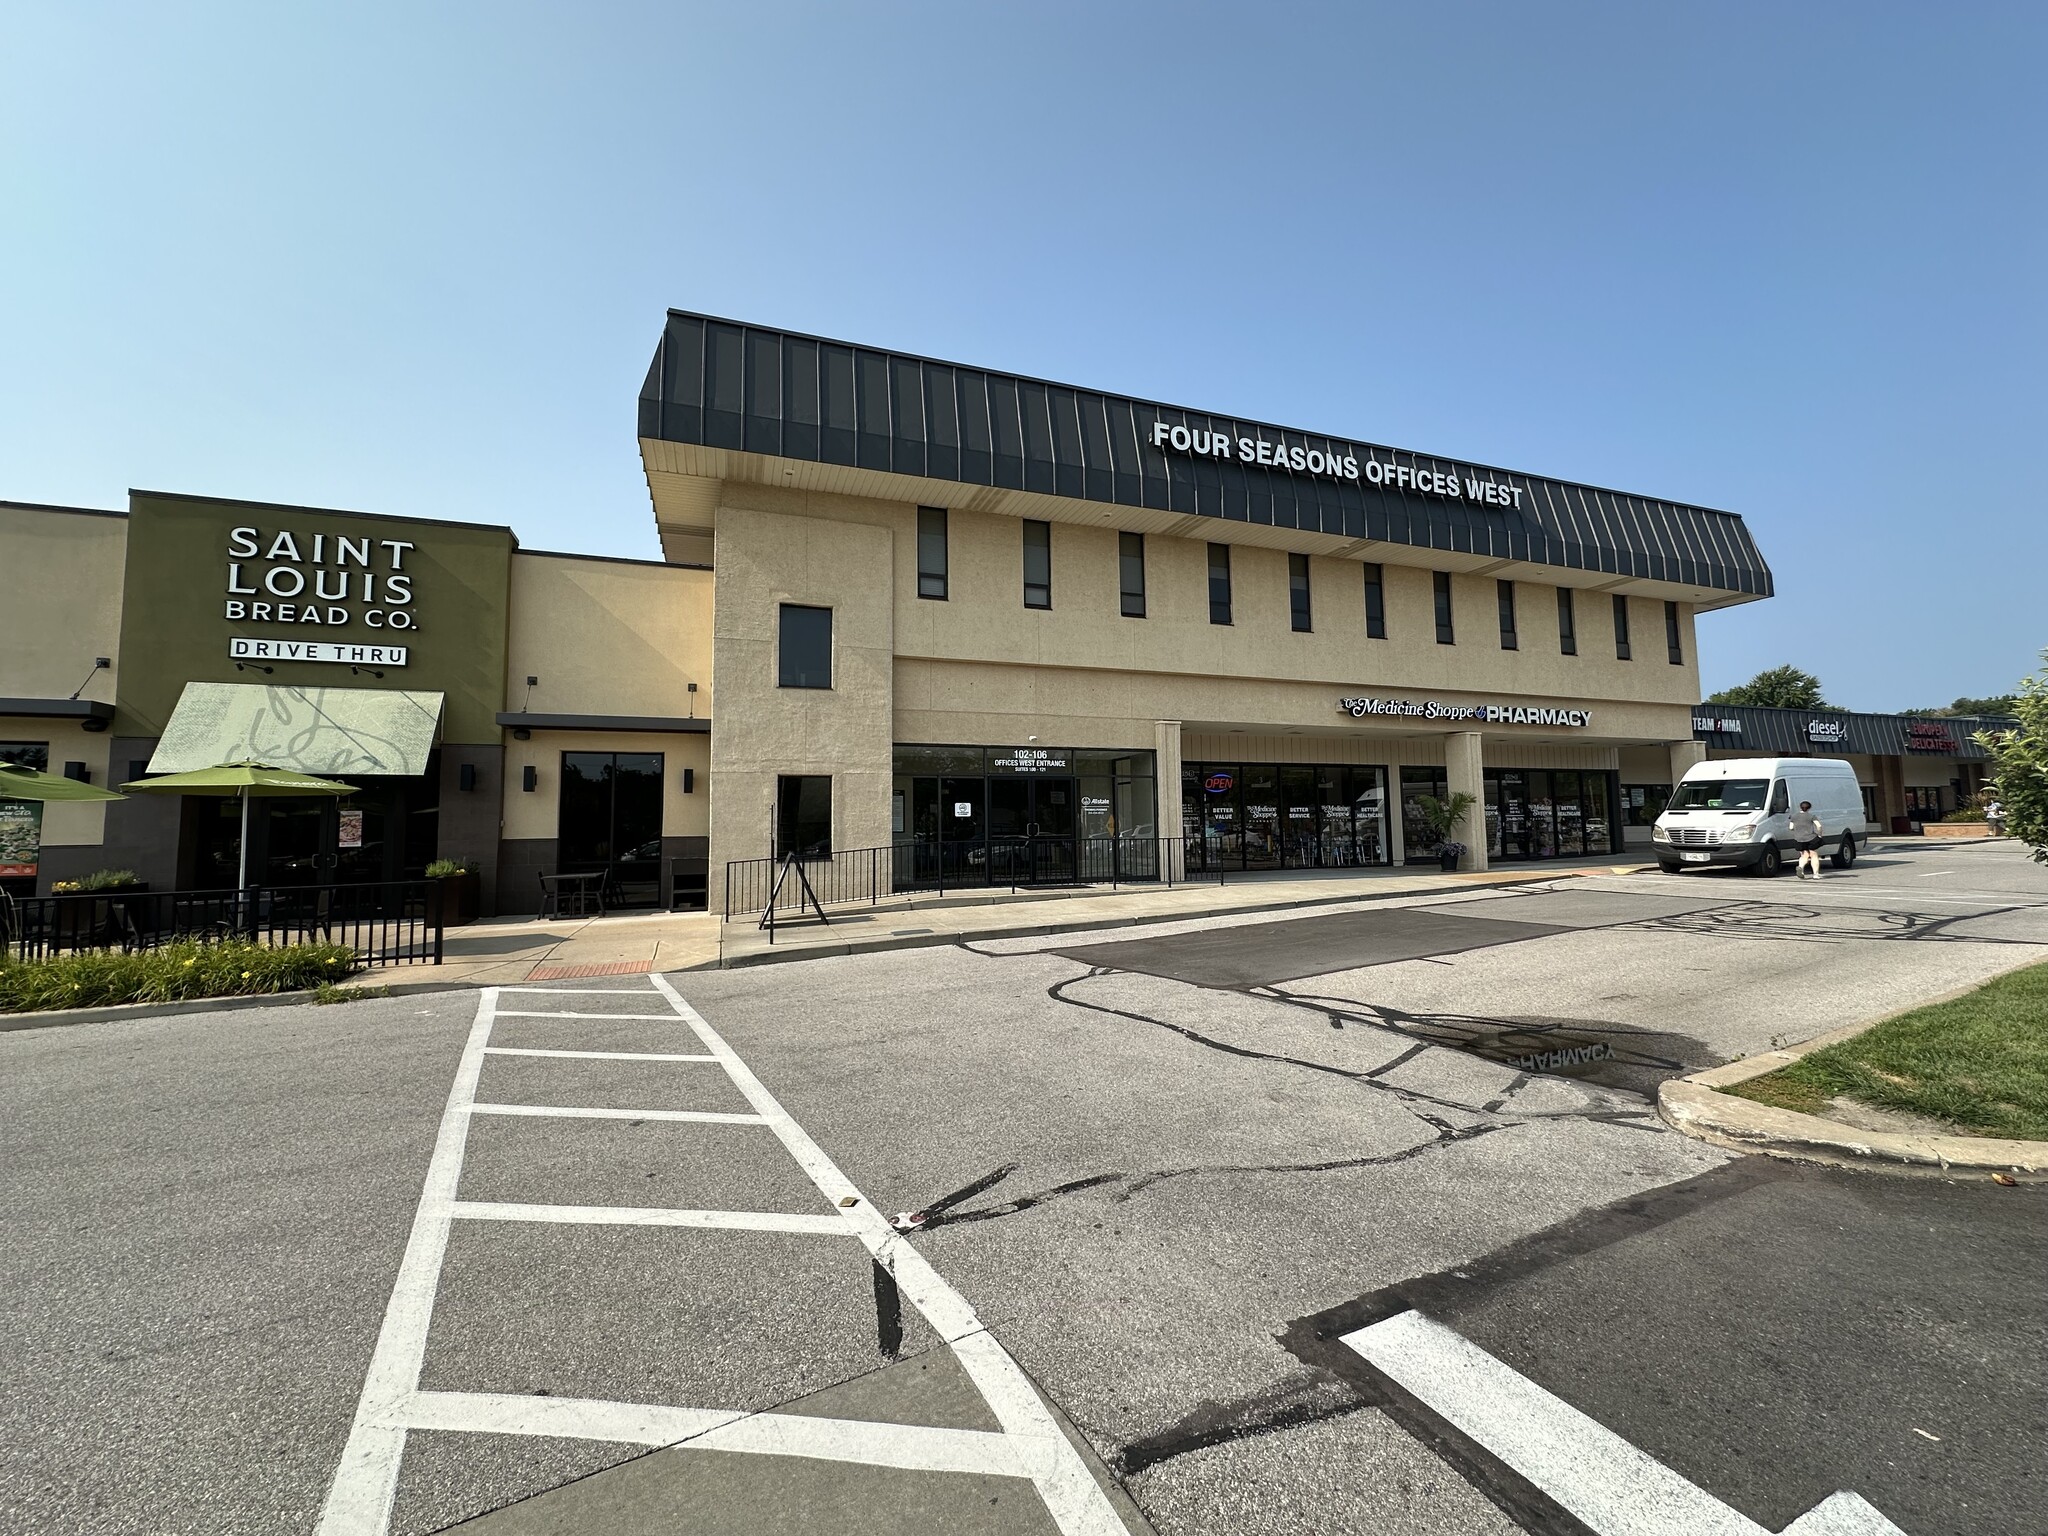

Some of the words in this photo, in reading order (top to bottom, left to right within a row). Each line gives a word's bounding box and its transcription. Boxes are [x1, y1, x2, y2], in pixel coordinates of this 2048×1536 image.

[1153, 421, 1231, 458] FOUR
[1238, 437, 1359, 480] SEASONS
[1365, 460, 1460, 498] OFFICES
[1465, 478, 1522, 508] WEST
[228, 527, 415, 570] SAINT
[227, 563, 412, 605] LOUIS
[225, 600, 349, 625] BREAD
[364, 609, 418, 630] CO.
[236, 641, 318, 659] DRIVE
[334, 646, 402, 663] THRU
[1353, 698, 1424, 718] Medicine
[1425, 701, 1474, 721] Shoppe
[1486, 706, 1592, 727] PHARMACY
[1693, 717, 1715, 731] TEAM
[1721, 719, 1741, 732] MMA
[1808, 720, 1839, 734] diesel
[1014, 750, 1048, 759] 102-106
[1205, 778, 1233, 788] OPEN
